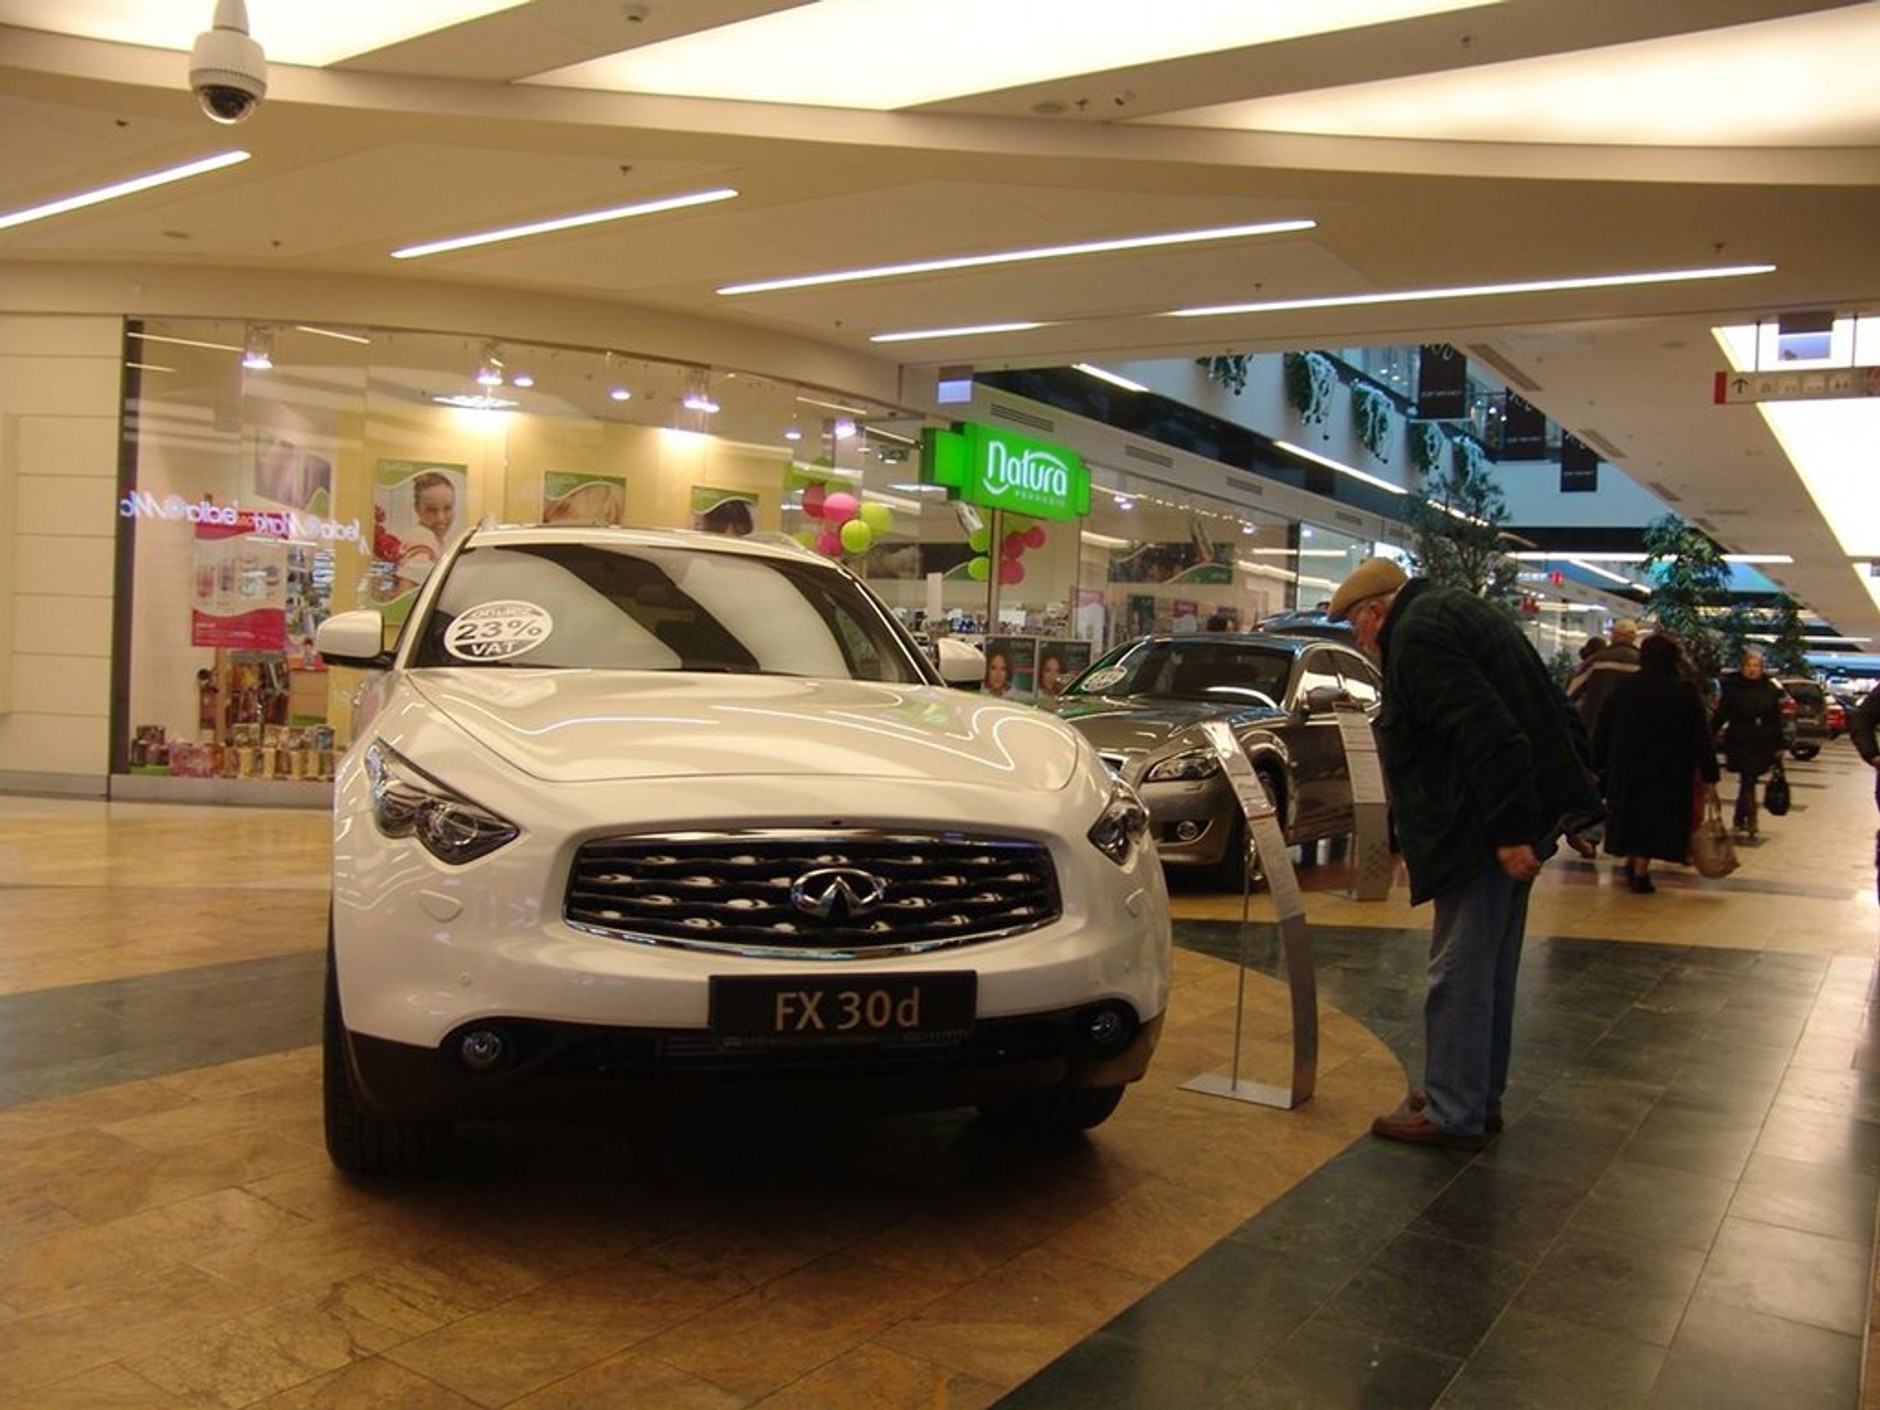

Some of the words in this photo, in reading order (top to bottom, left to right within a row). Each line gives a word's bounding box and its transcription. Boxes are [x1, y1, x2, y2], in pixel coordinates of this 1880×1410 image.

[455, 620, 542, 640] 23%
[471, 642, 516, 656] VAT
[775, 992, 824, 1030] FX
[837, 987, 920, 1030] 30d
